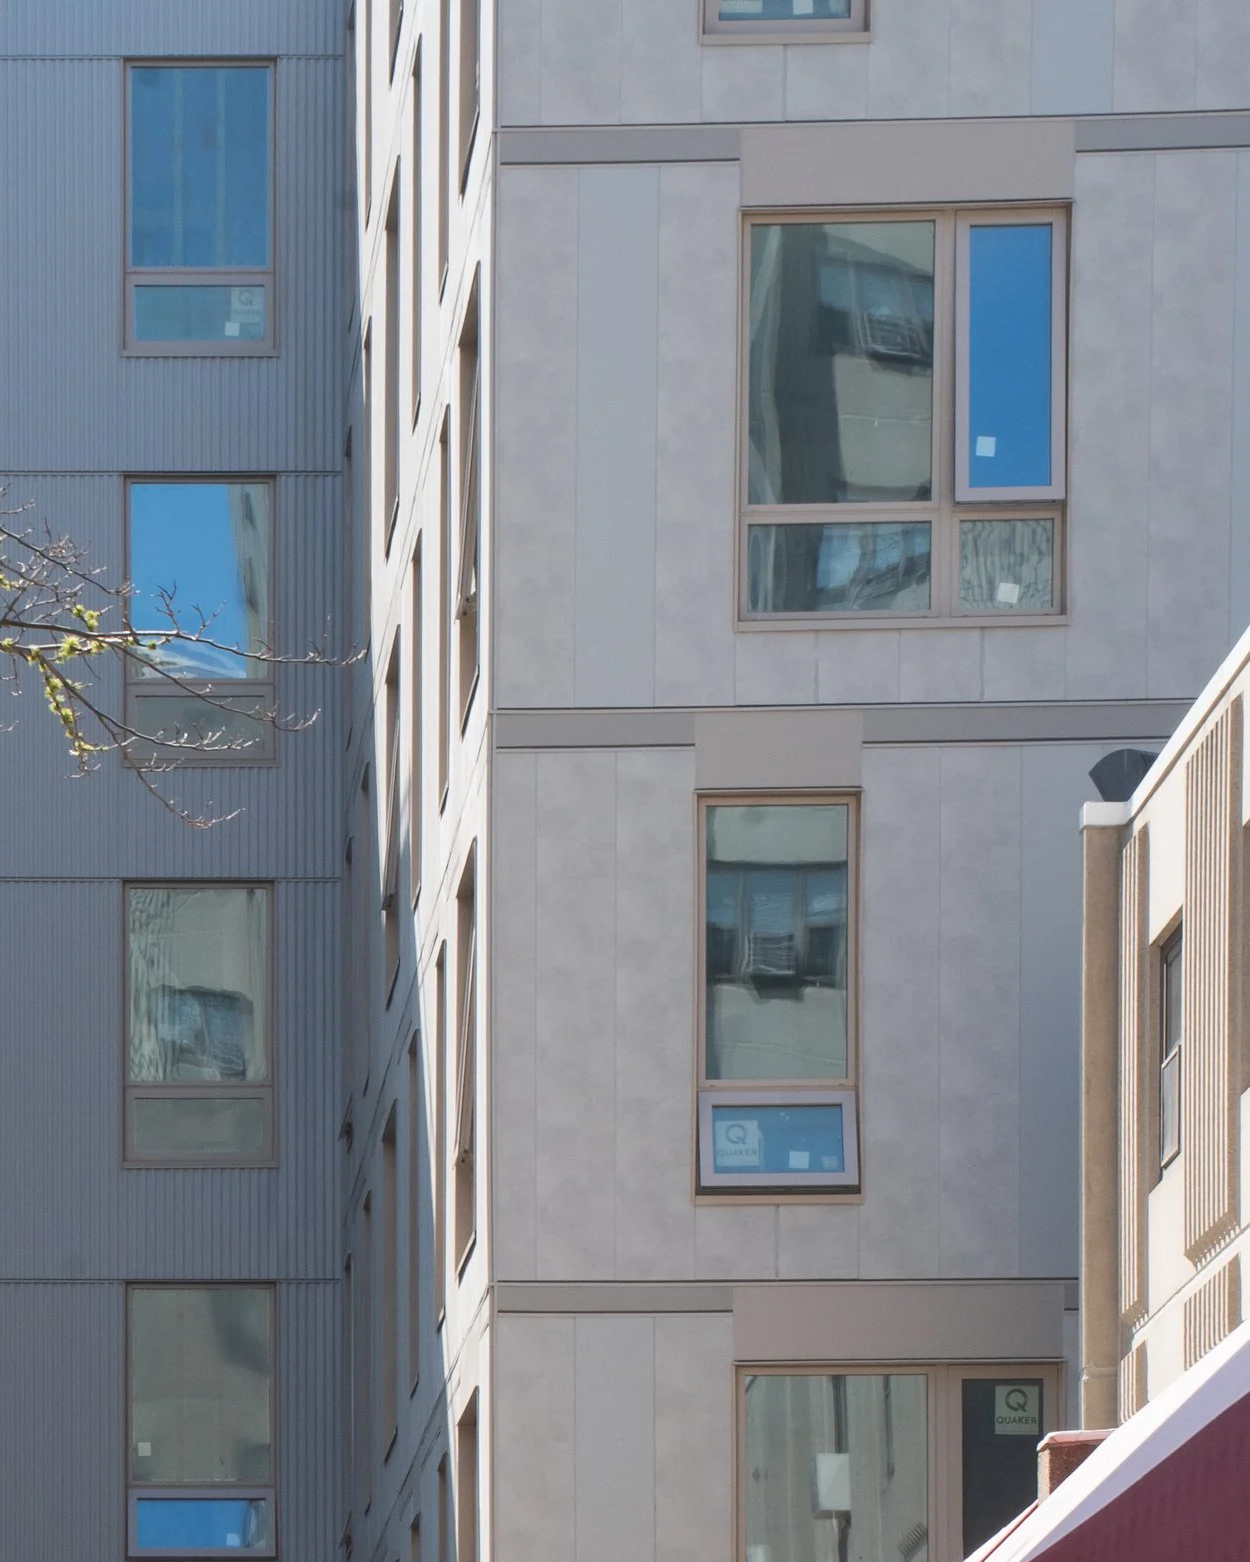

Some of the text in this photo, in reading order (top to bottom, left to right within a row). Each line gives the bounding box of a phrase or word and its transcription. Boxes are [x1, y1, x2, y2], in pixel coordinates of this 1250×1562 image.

[725, 1123, 748, 1146] Q
[716, 1148, 758, 1158] QUAKER
[1005, 1389, 1028, 1412] Q
[996, 1416, 1038, 1425] QUAKER
